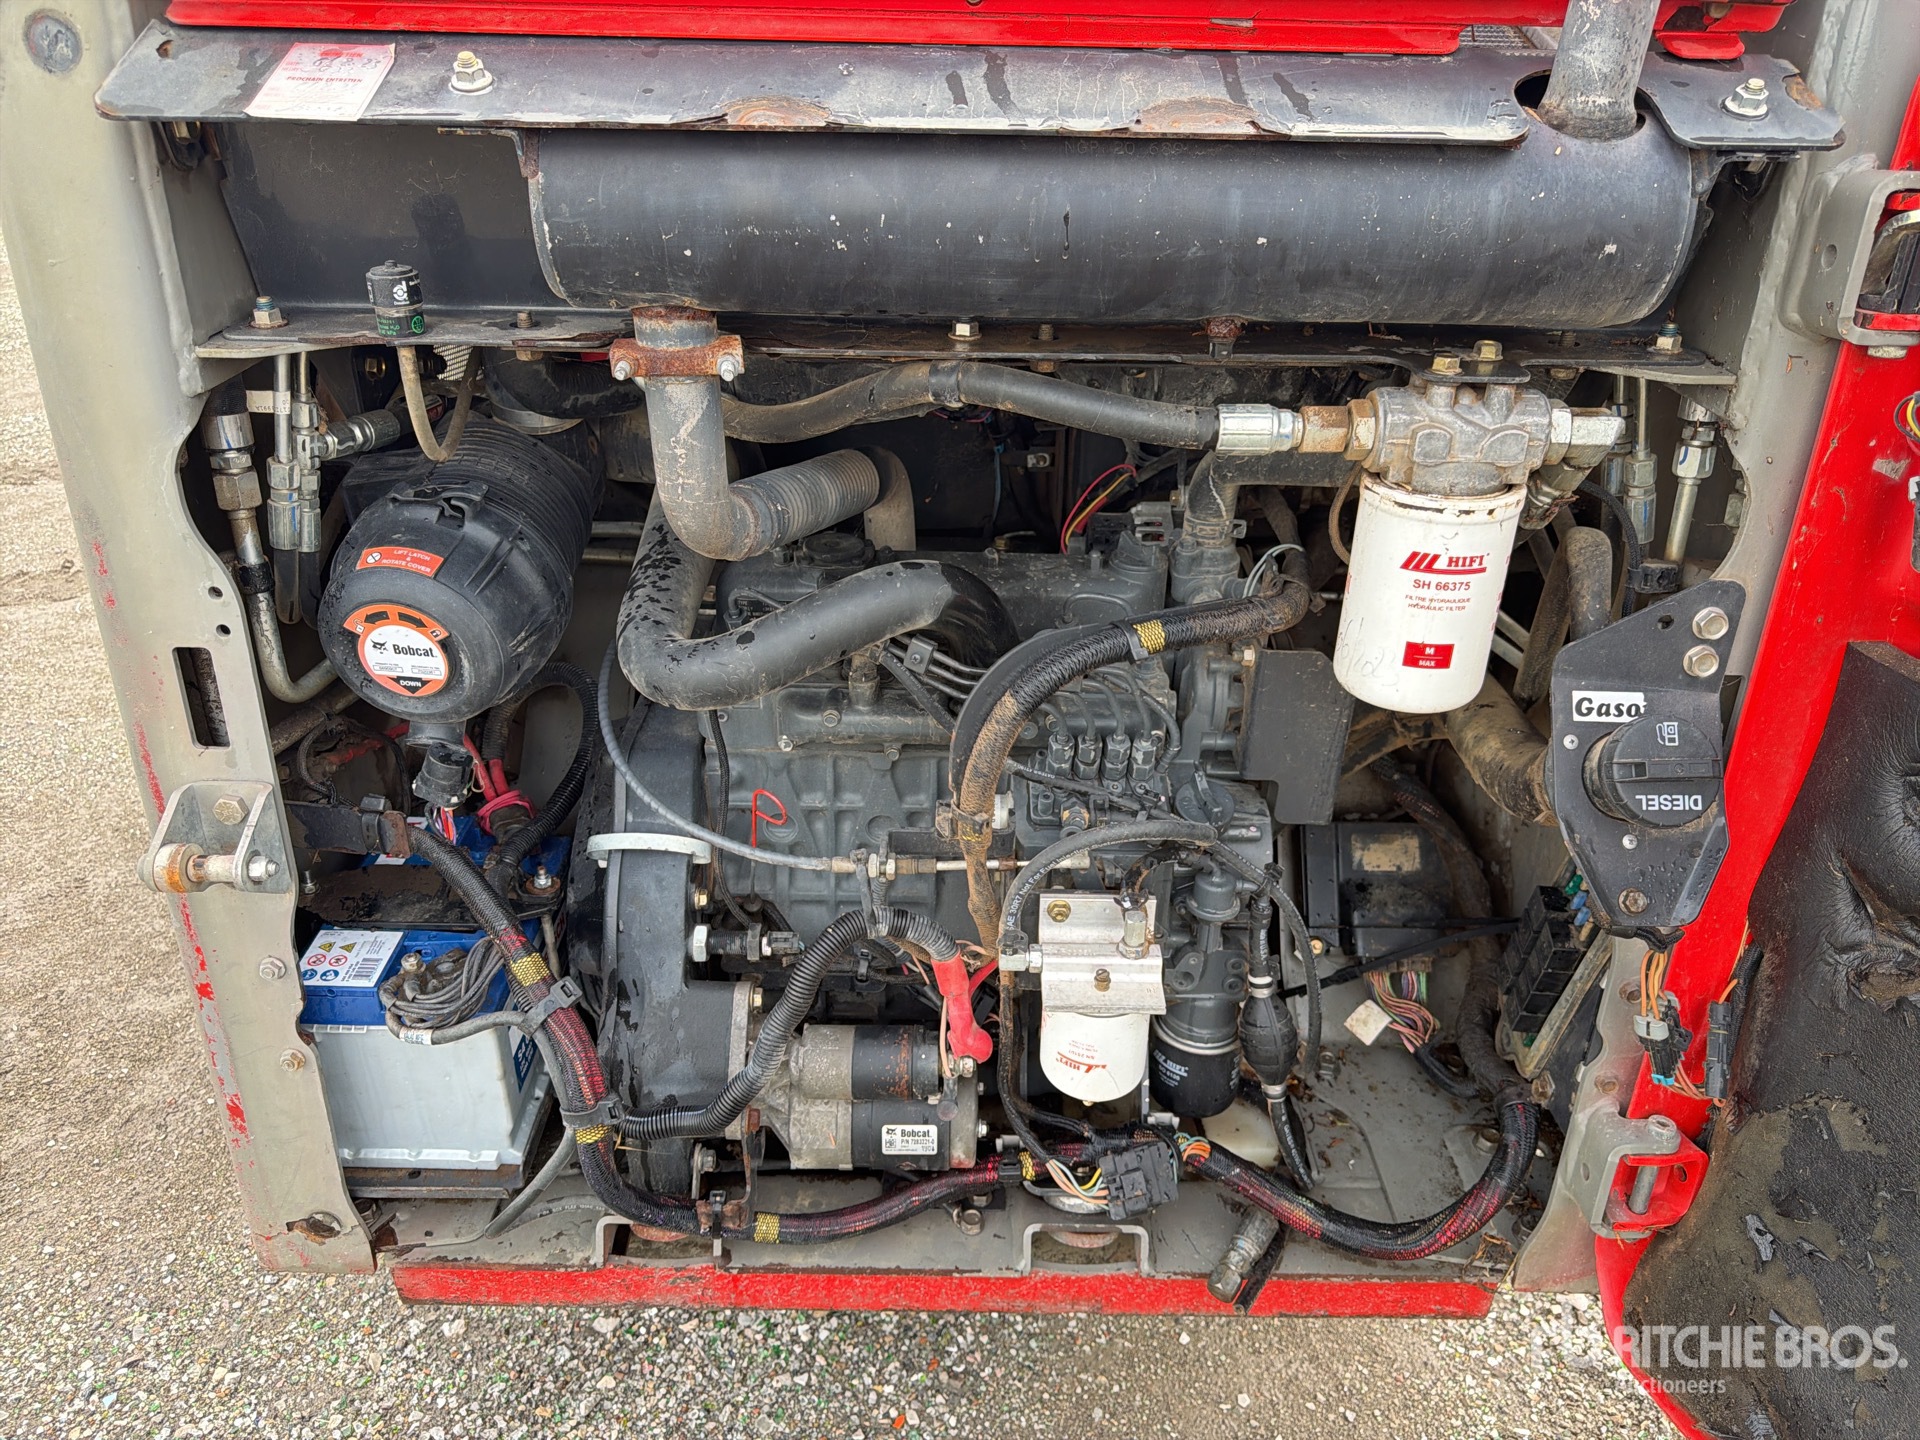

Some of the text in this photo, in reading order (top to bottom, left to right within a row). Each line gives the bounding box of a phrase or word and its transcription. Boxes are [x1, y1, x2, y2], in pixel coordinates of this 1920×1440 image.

[408, 551, 431, 561] LATCH
[1446, 554, 1486, 568] HIFI
[407, 562, 431, 573] COVER
[1412, 579, 1471, 591] SH 66375
[1405, 594, 1471, 604] FILTRE HYDRAULIQUE
[1407, 603, 1467, 612] HYDRAULIC FILTER
[392, 643, 436, 658] Bobcat
[1425, 647, 1435, 655] M
[399, 680, 422, 688] DOWN
[1635, 795, 1703, 811] DIESEL
[1010, 894, 1022, 915] 30R7
[1018, 882, 1031, 897] Not
[1028, 870, 1042, 886] For
[1039, 859, 1058, 875] Fuel
[900, 1128, 931, 1138] Bobcat
